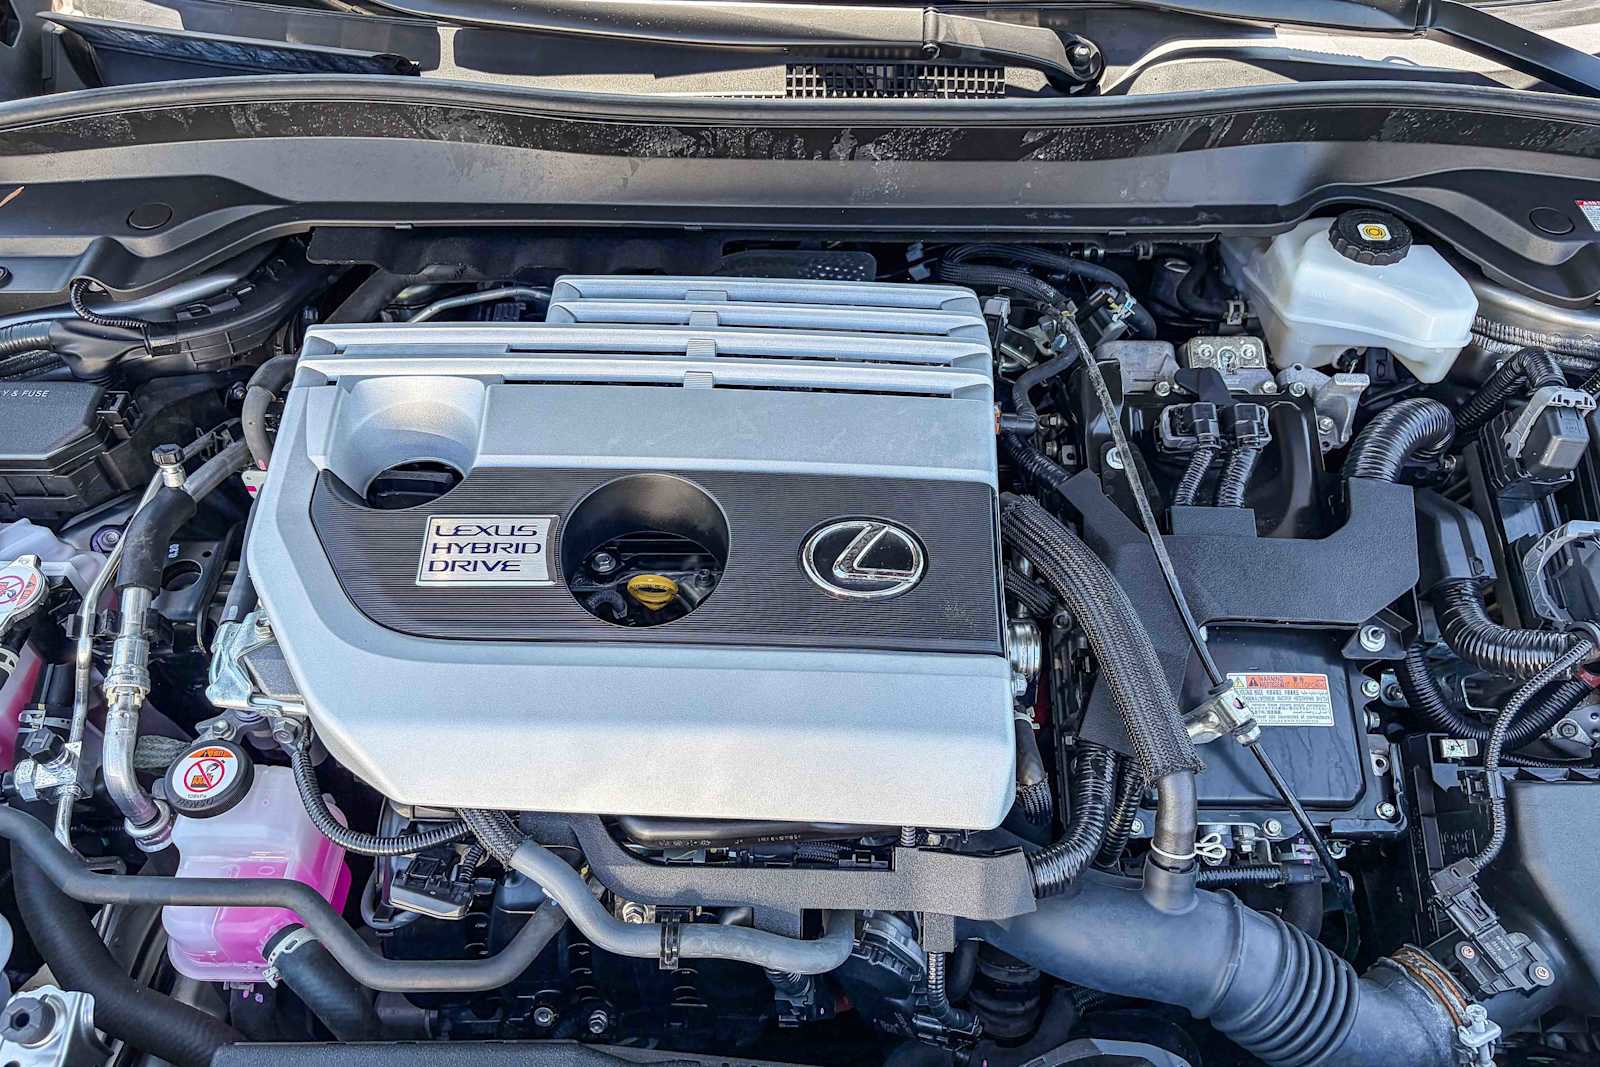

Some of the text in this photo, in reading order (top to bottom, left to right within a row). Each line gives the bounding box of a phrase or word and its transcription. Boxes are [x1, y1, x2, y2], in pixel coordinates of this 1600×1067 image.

[22, 390, 50, 398] FUSE
[435, 524, 538, 537] LEXUS
[431, 542, 542, 555] HYBRID
[428, 559, 522, 572] DRIVE
[26, 732, 50, 749] H
